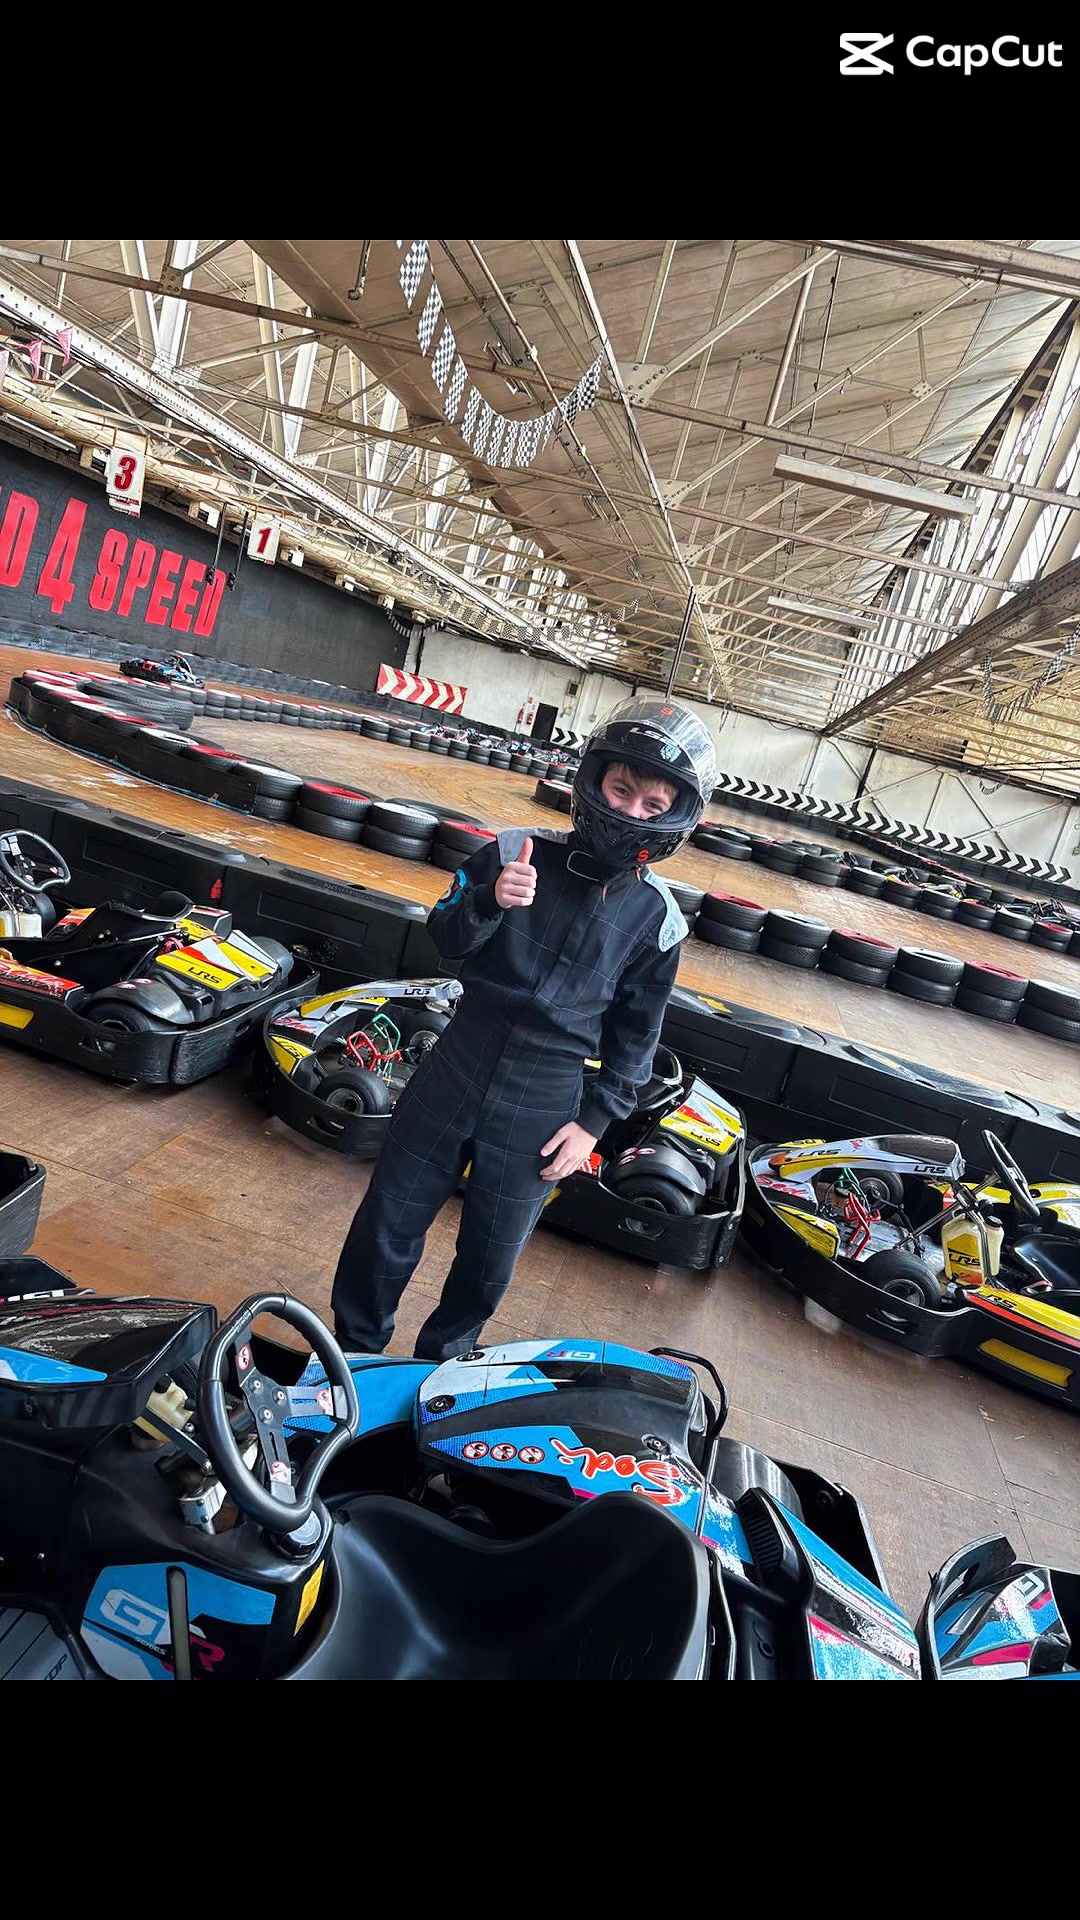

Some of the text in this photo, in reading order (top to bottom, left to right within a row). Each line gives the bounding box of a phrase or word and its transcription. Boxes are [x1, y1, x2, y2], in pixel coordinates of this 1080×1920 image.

[114, 455, 136, 490] 3
[257, 527, 272, 554] 1
[0, 489, 227, 637] D 4 SPEED
[637, 849, 649, 863] S
[187, 966, 222, 984] LRS
[404, 988, 432, 996] LRS
[913, 1164, 948, 1175] LRS
[546, 1349, 597, 1361] GTR
